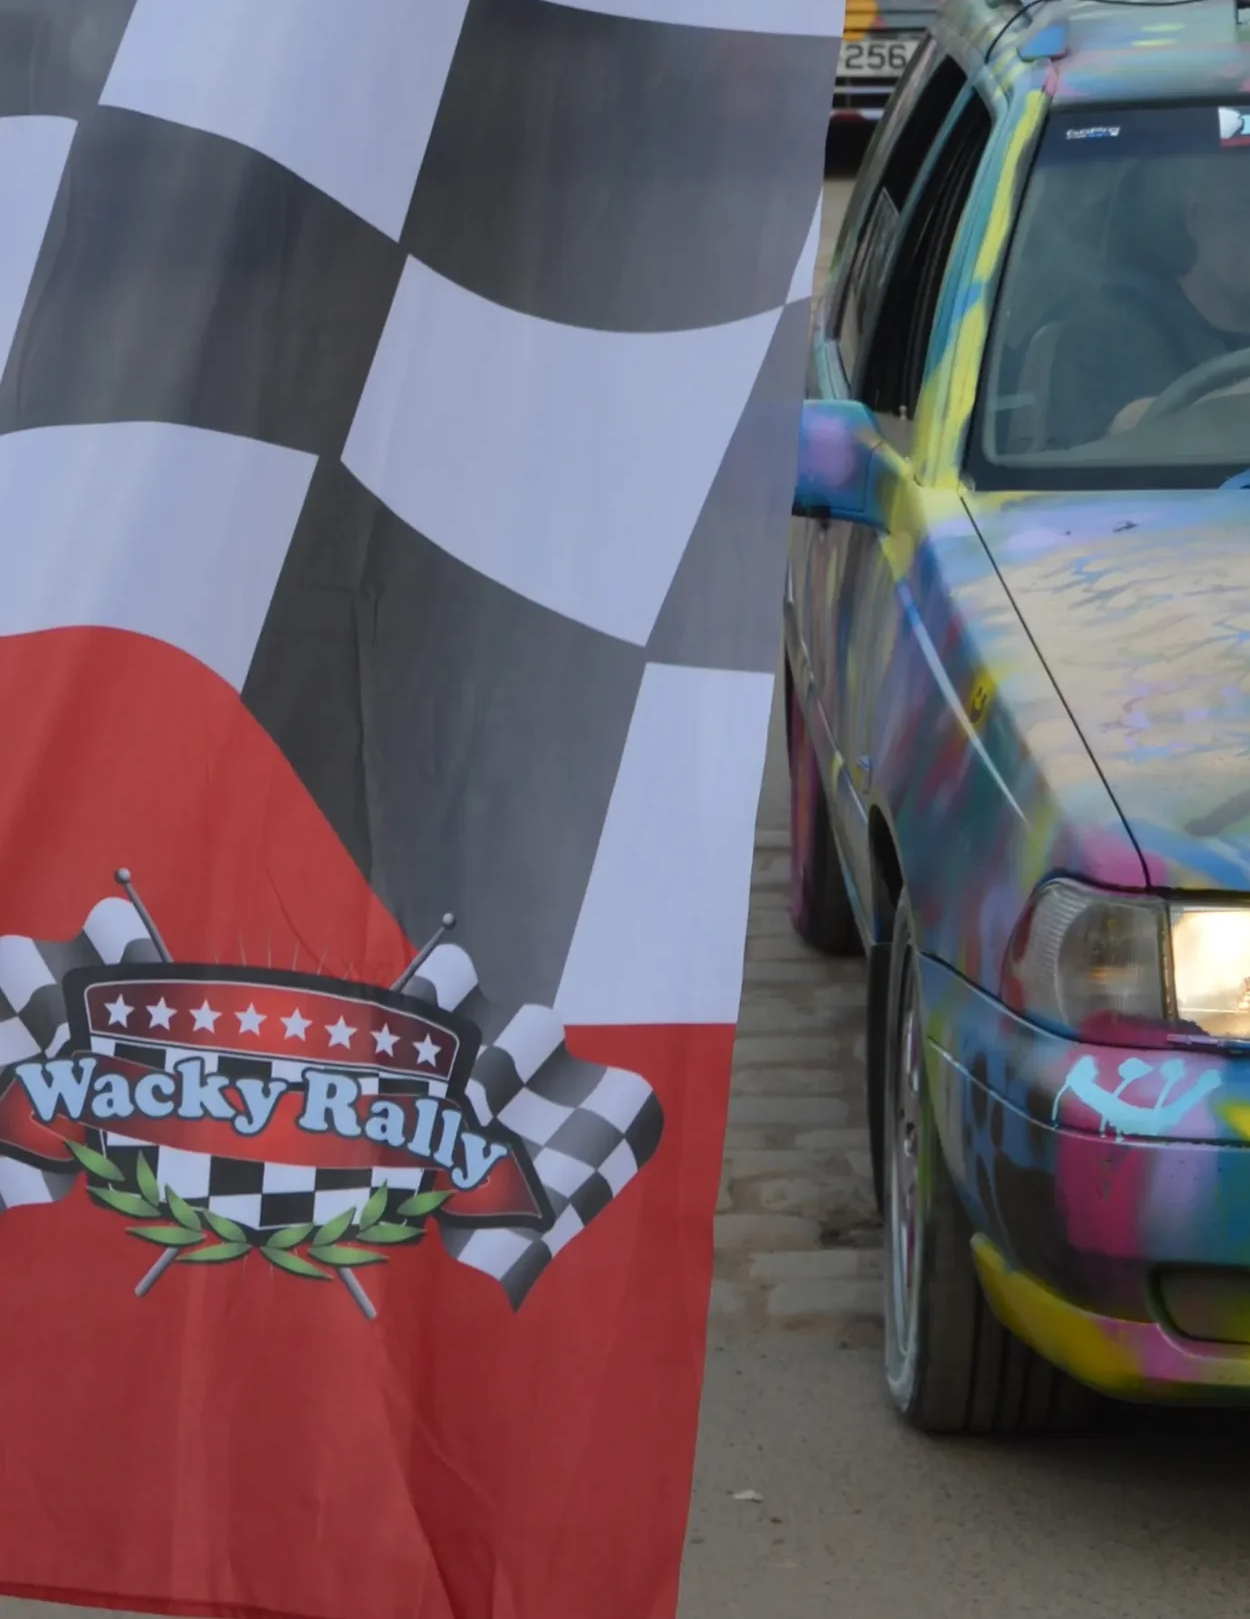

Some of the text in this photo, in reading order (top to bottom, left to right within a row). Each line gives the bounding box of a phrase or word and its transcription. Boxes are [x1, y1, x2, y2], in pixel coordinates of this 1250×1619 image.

[842, 43, 908, 71] 256
[15, 1057, 508, 1189] Wacky Rally
